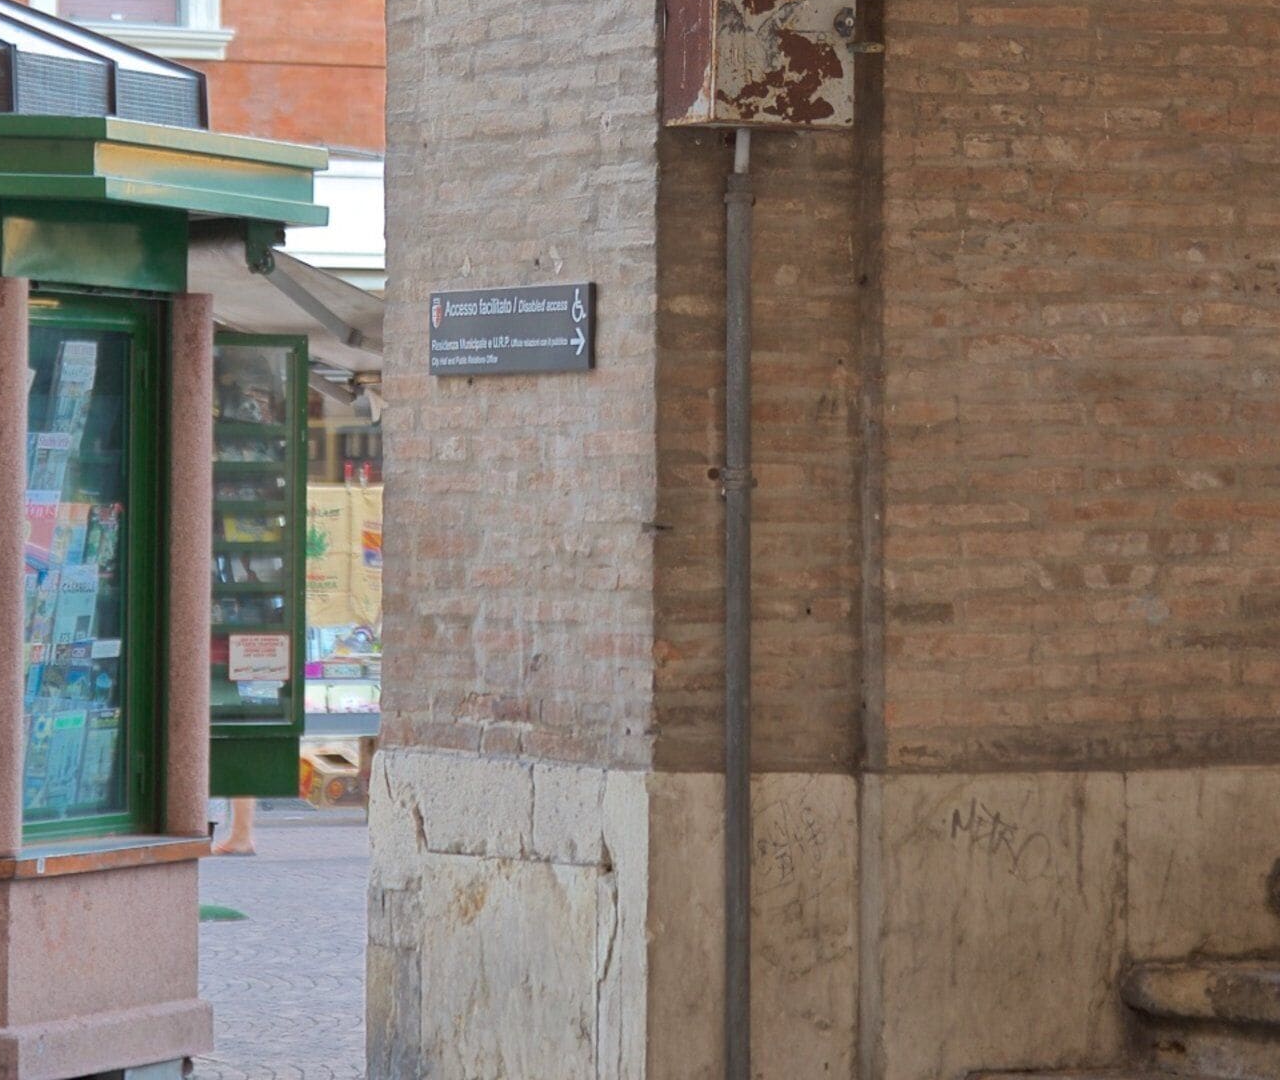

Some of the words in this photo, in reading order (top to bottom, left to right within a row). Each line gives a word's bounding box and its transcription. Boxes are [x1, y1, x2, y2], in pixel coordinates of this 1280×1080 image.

[444, 300, 478, 317] Accesso
[479, 297, 512, 315] facilitato
[518, 299, 546, 314] Disabled
[546, 300, 568, 312] access
